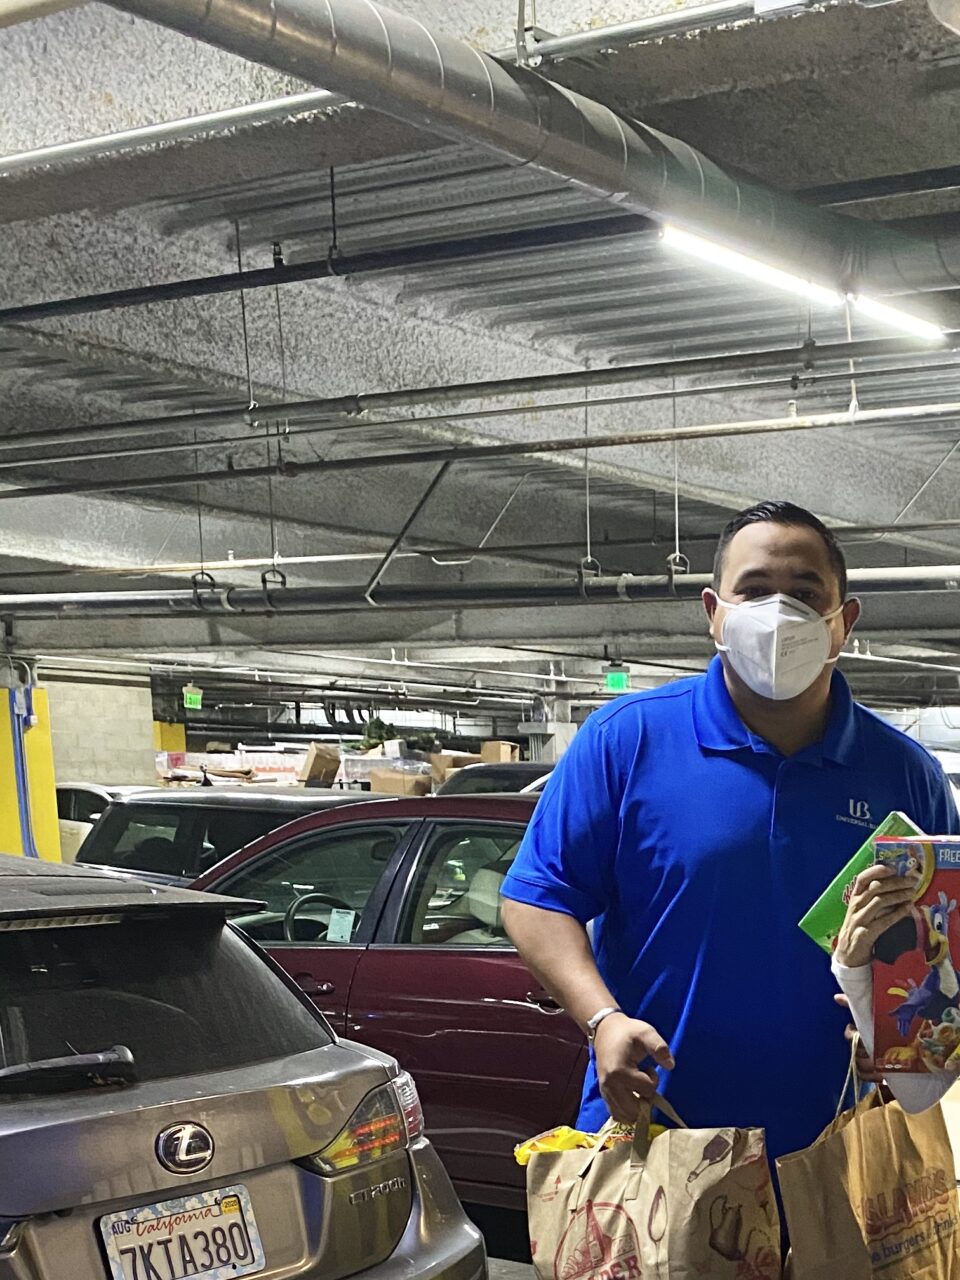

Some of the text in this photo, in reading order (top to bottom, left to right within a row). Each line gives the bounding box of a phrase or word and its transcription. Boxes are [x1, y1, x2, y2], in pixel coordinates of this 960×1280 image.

[939, 848, 960, 863] FREE
[111, 1221, 132, 1236] AUG
[136, 1206, 222, 1237] California
